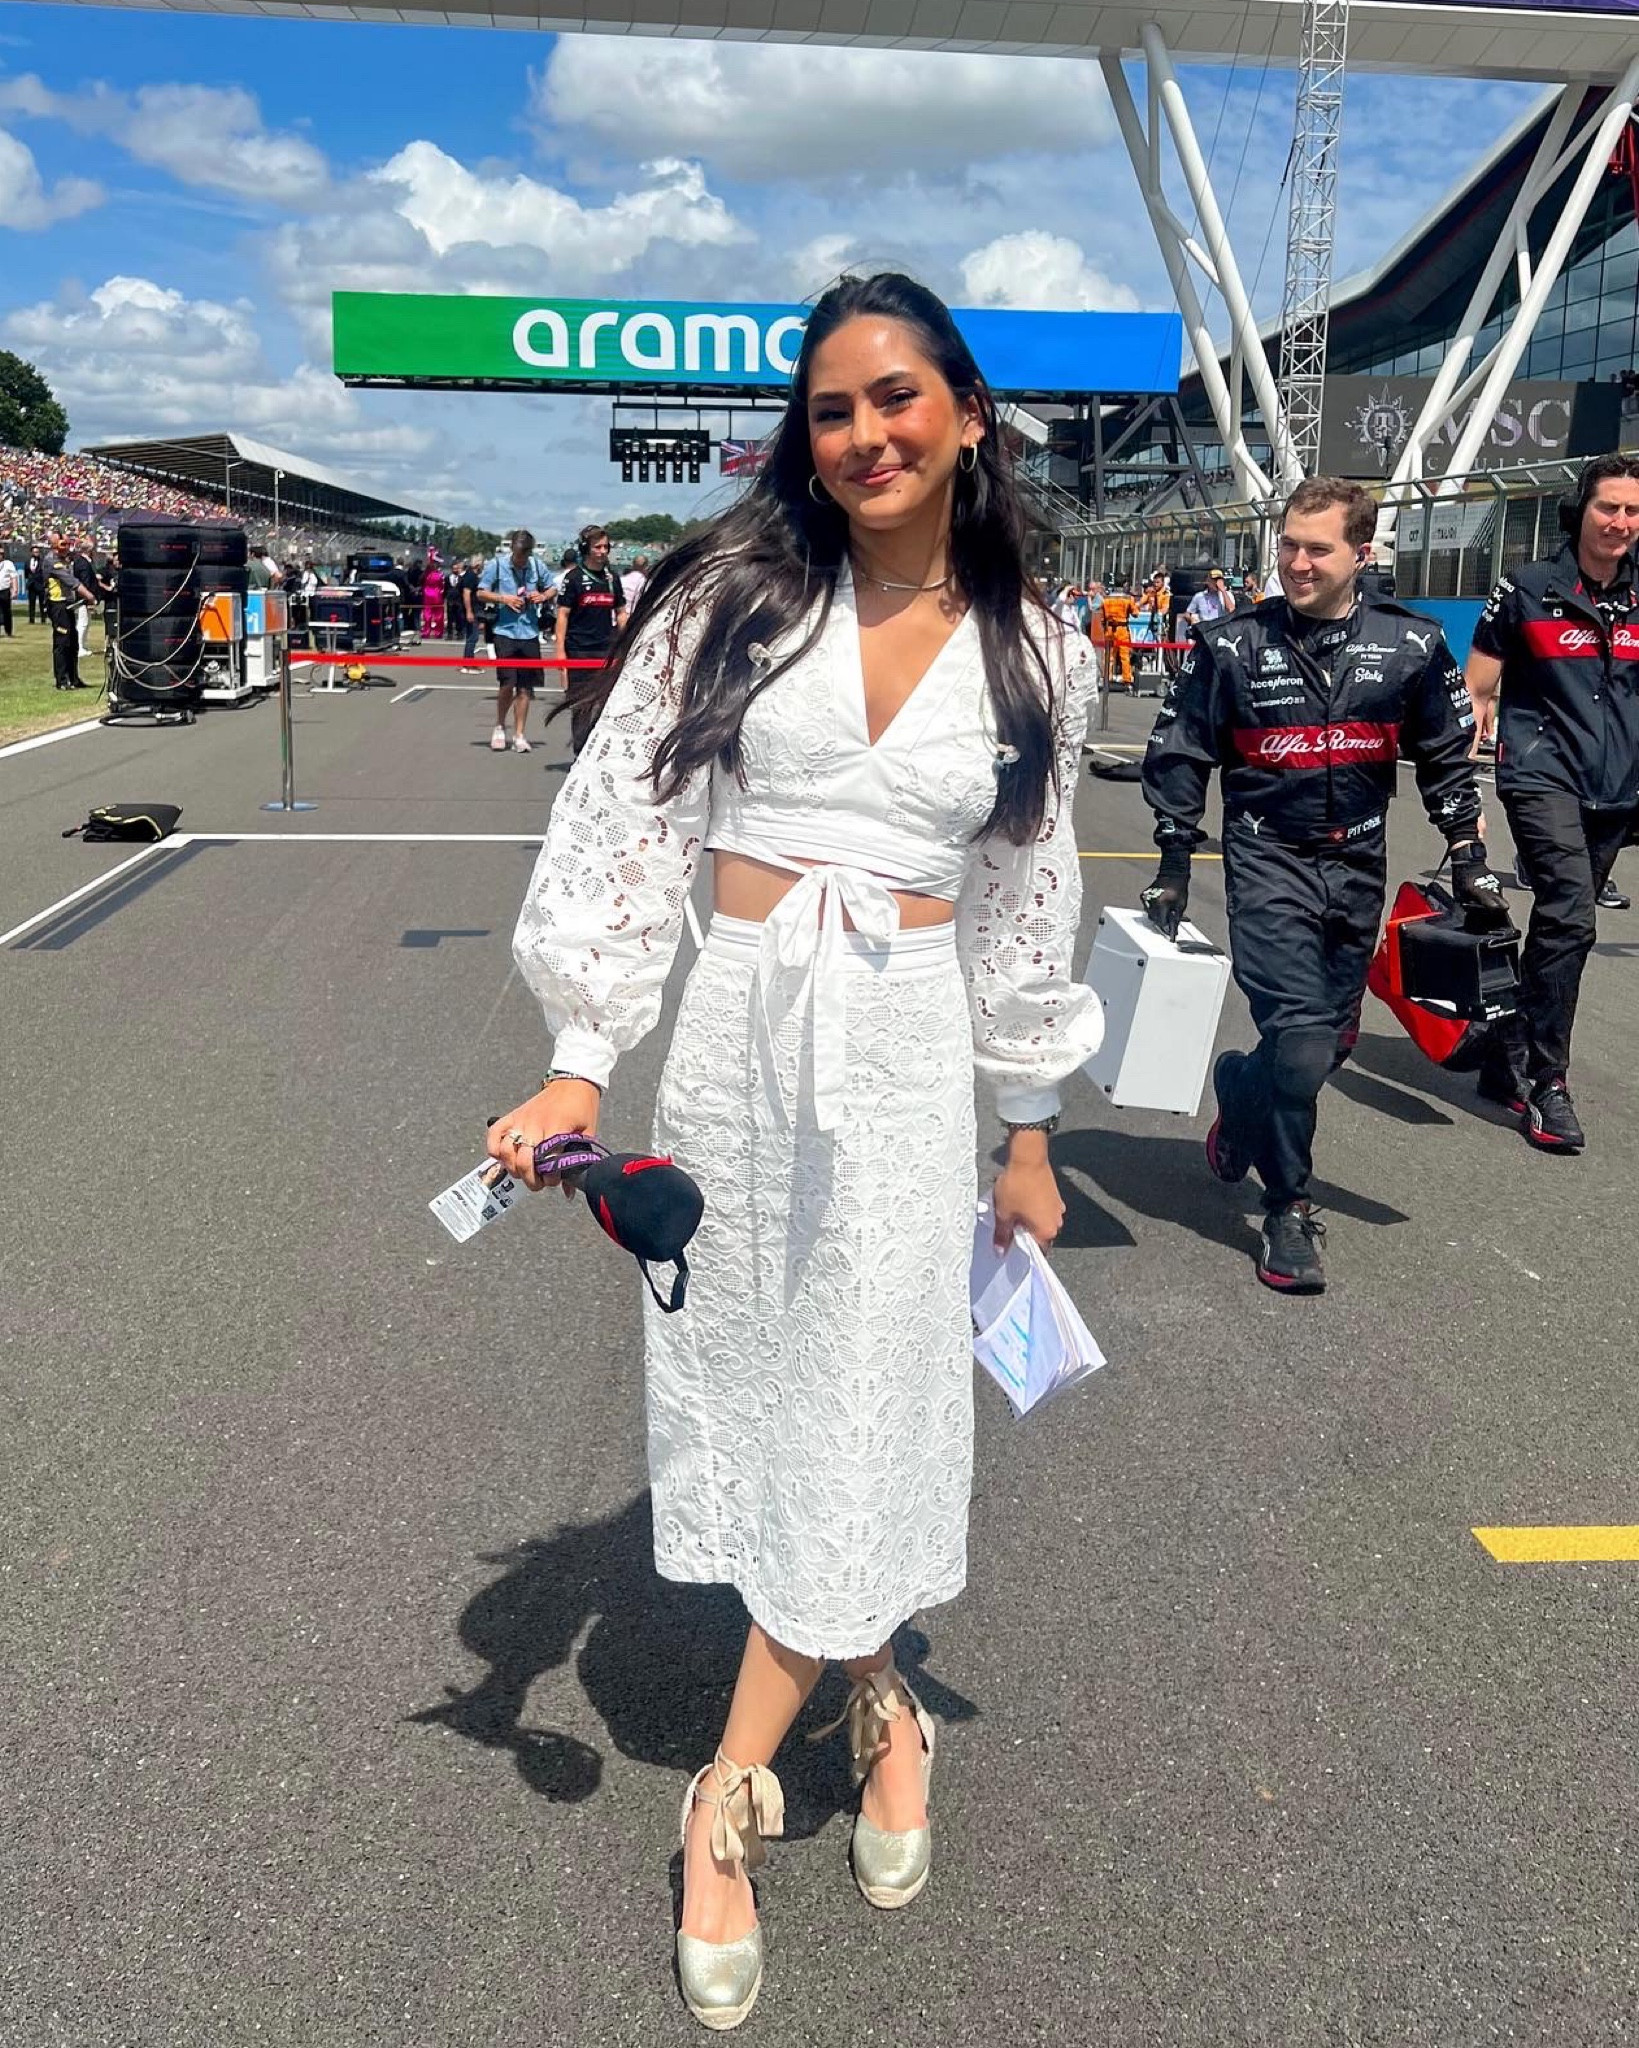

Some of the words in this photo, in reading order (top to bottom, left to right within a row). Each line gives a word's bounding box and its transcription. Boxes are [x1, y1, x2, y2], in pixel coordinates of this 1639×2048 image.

[512, 308, 806, 375] aramc
[1260, 734, 1313, 762] Alfa
[1312, 729, 1384, 753] Romeo
